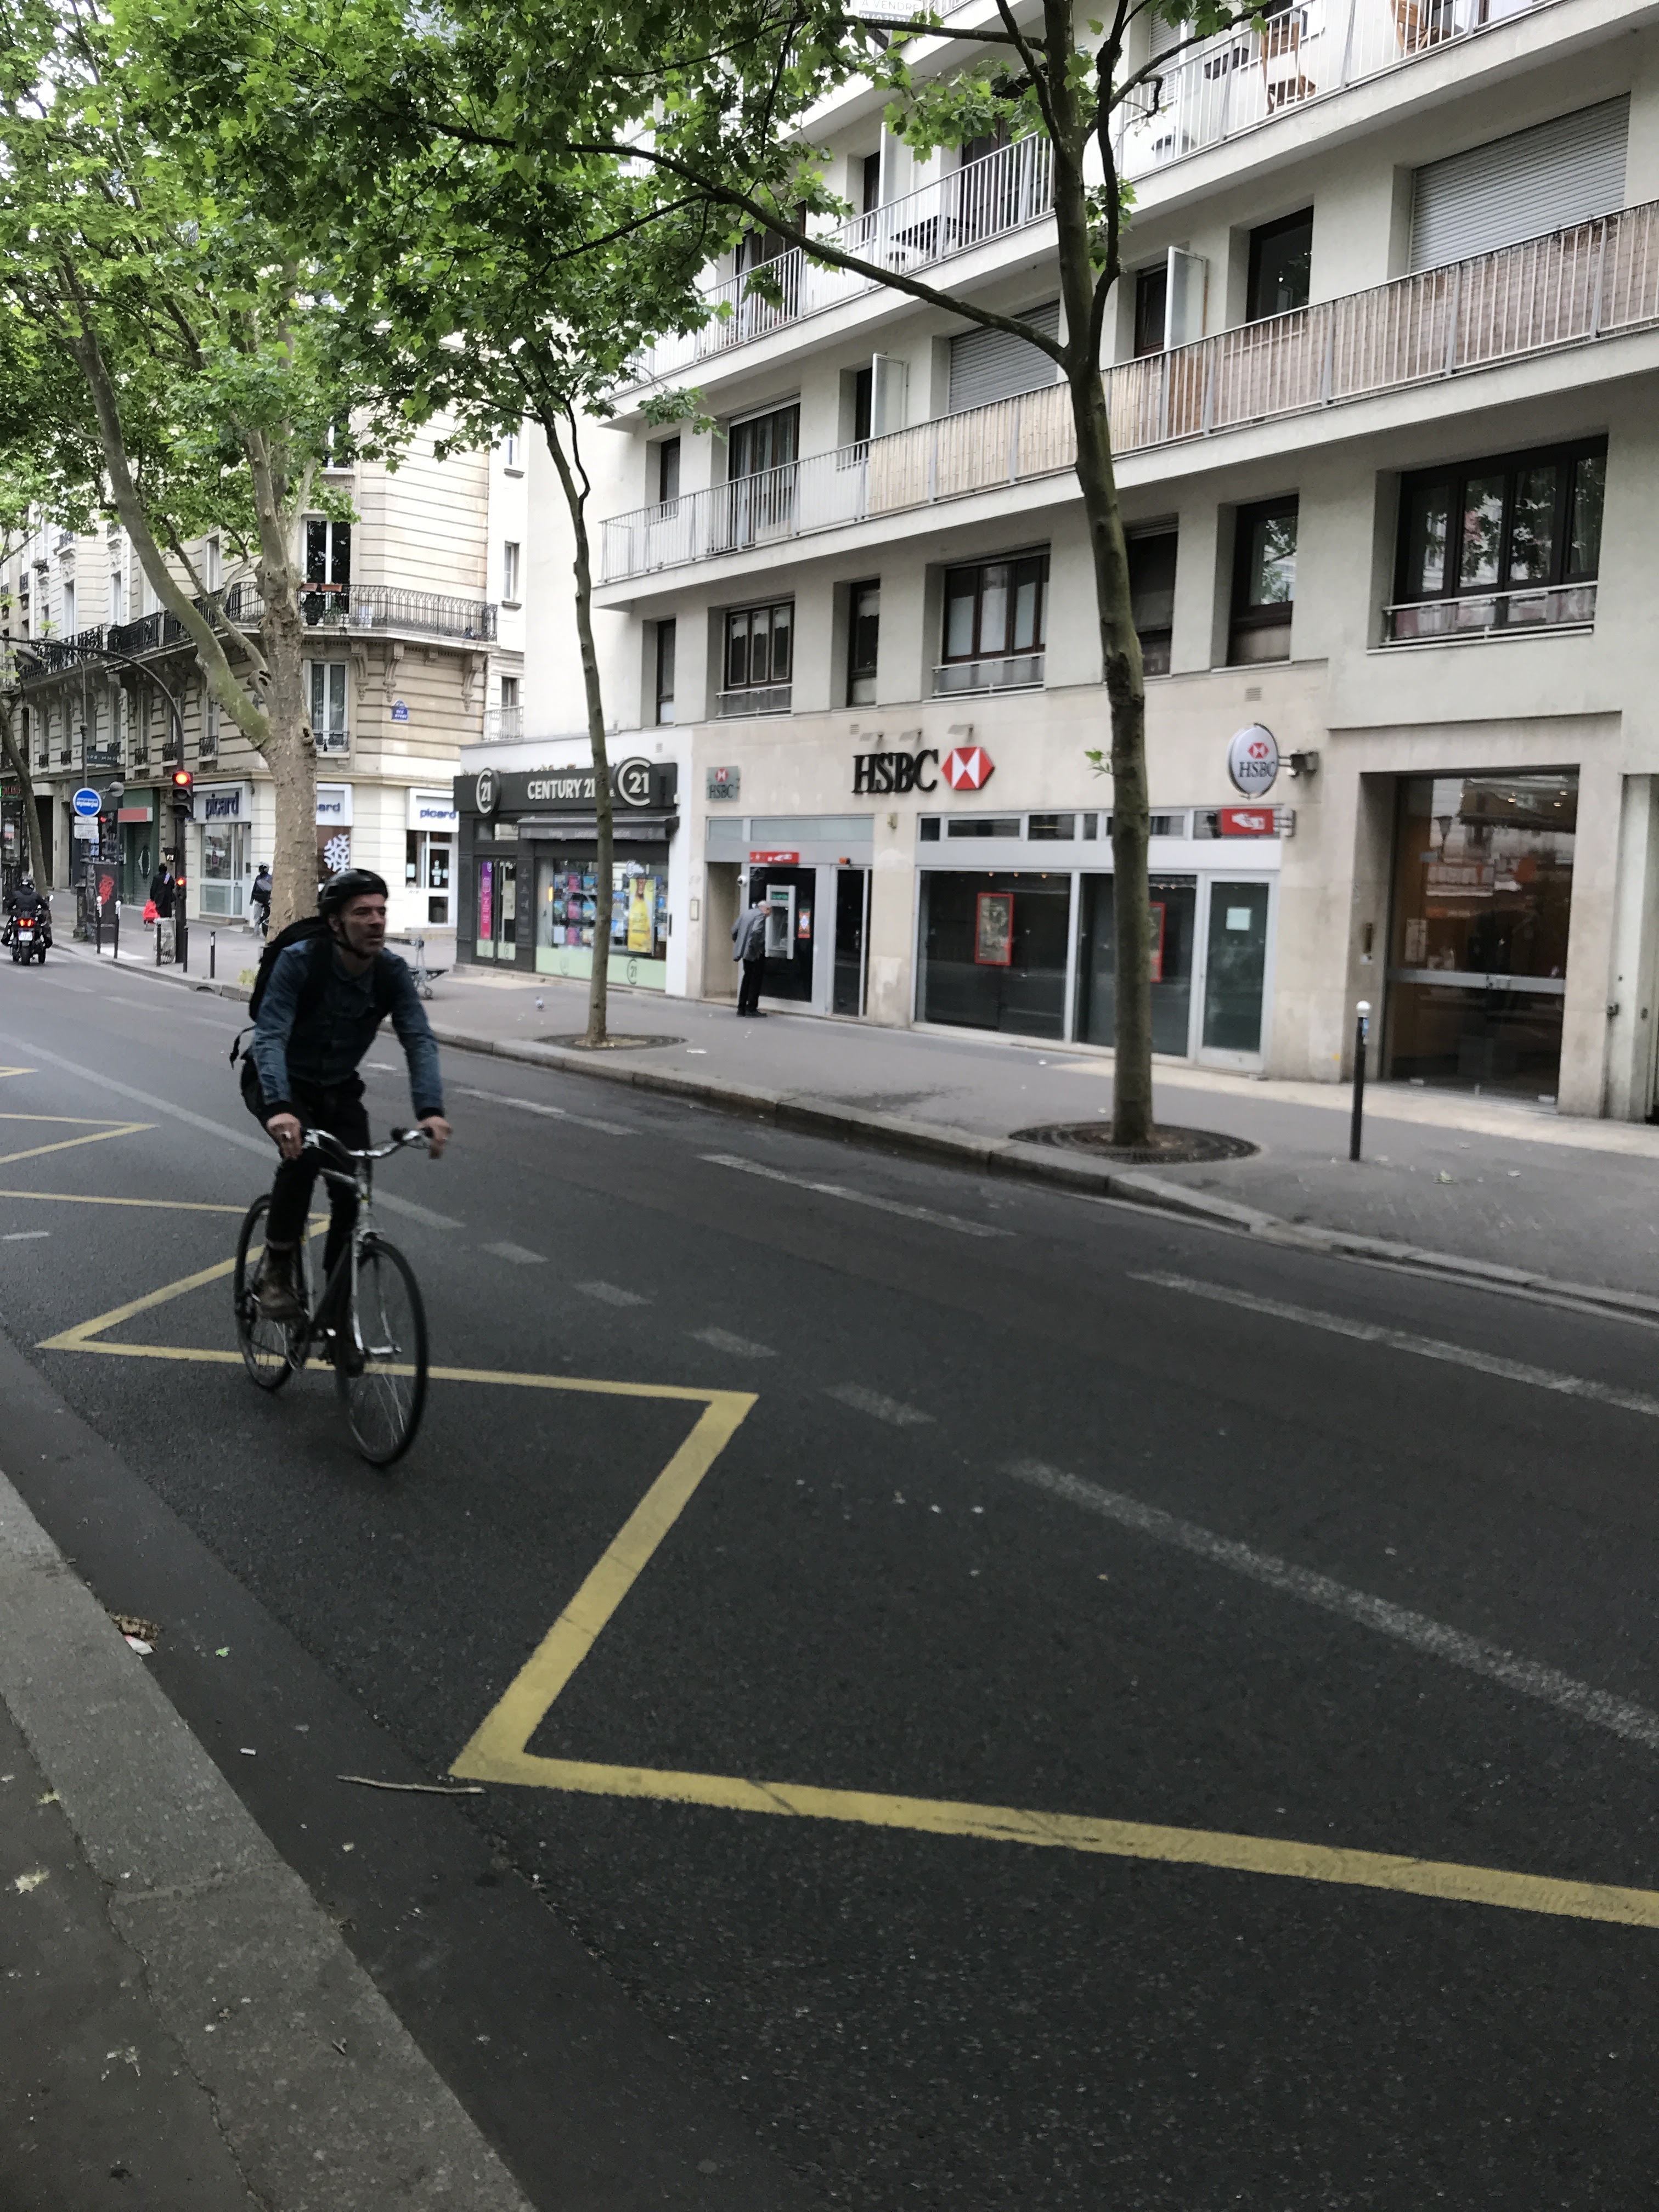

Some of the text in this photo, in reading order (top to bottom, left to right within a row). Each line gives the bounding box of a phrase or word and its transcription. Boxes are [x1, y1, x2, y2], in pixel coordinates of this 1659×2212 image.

[851, 749, 939, 794] HSBC
[1238, 761, 1276, 777] HSBC
[527, 778, 583, 800] CENTURY
[584, 778, 595, 798] 21
[709, 784, 733, 799] HSBC
[205, 791, 239, 820] picard
[420, 809, 456, 820] picard
